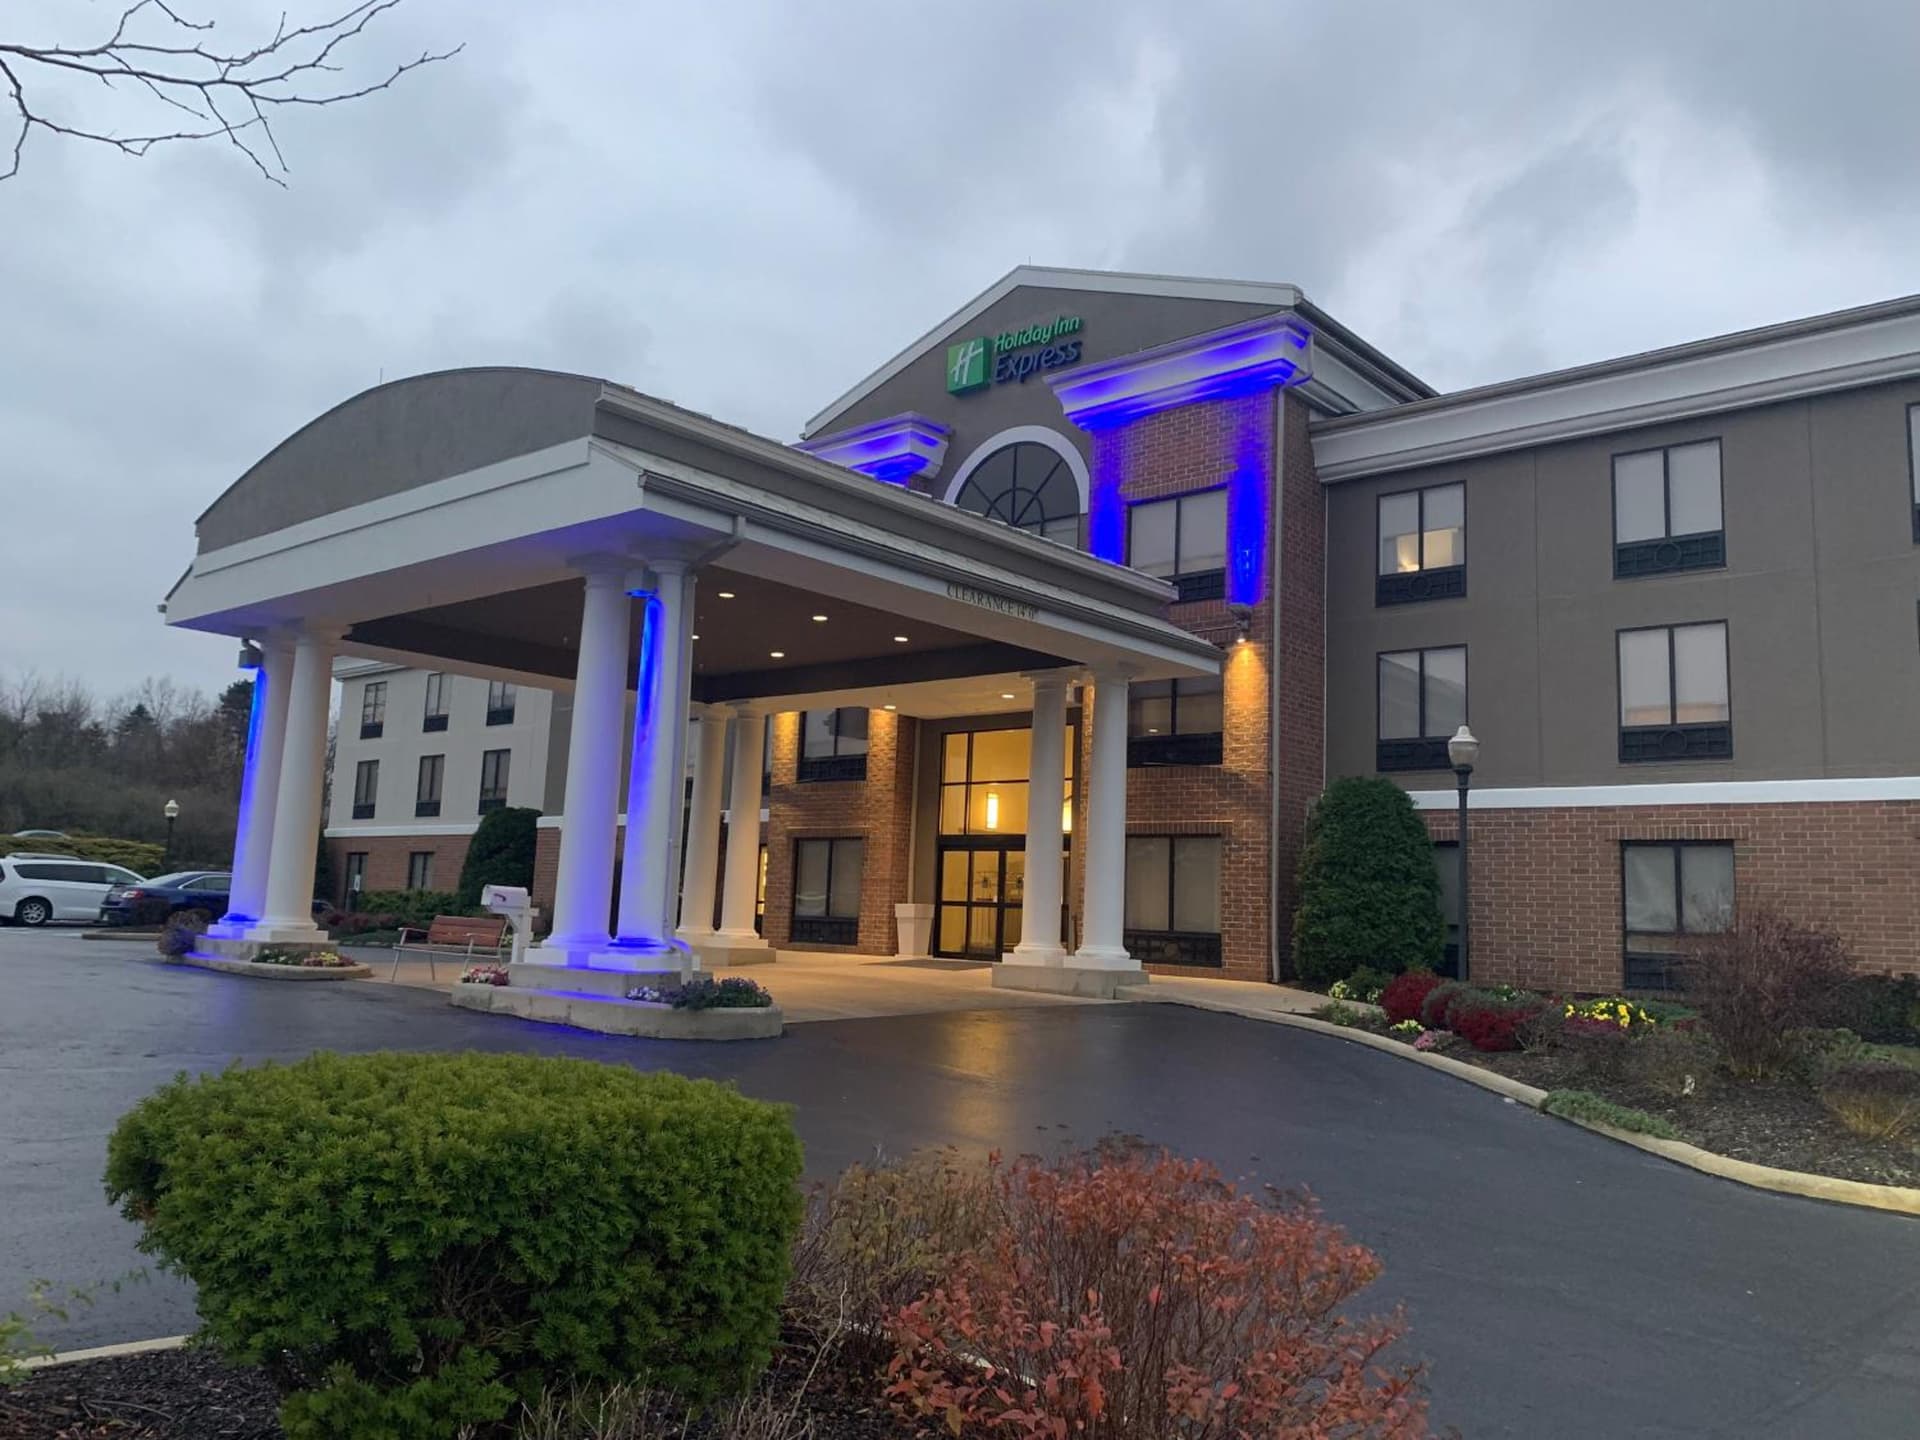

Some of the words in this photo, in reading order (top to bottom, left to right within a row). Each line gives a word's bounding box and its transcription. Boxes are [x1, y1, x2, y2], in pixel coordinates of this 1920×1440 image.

[994, 321, 1052, 352] Holiday
[1054, 314, 1081, 335] Inn
[993, 340, 1081, 383] Express
[946, 583, 1015, 616] CLEARANCE
